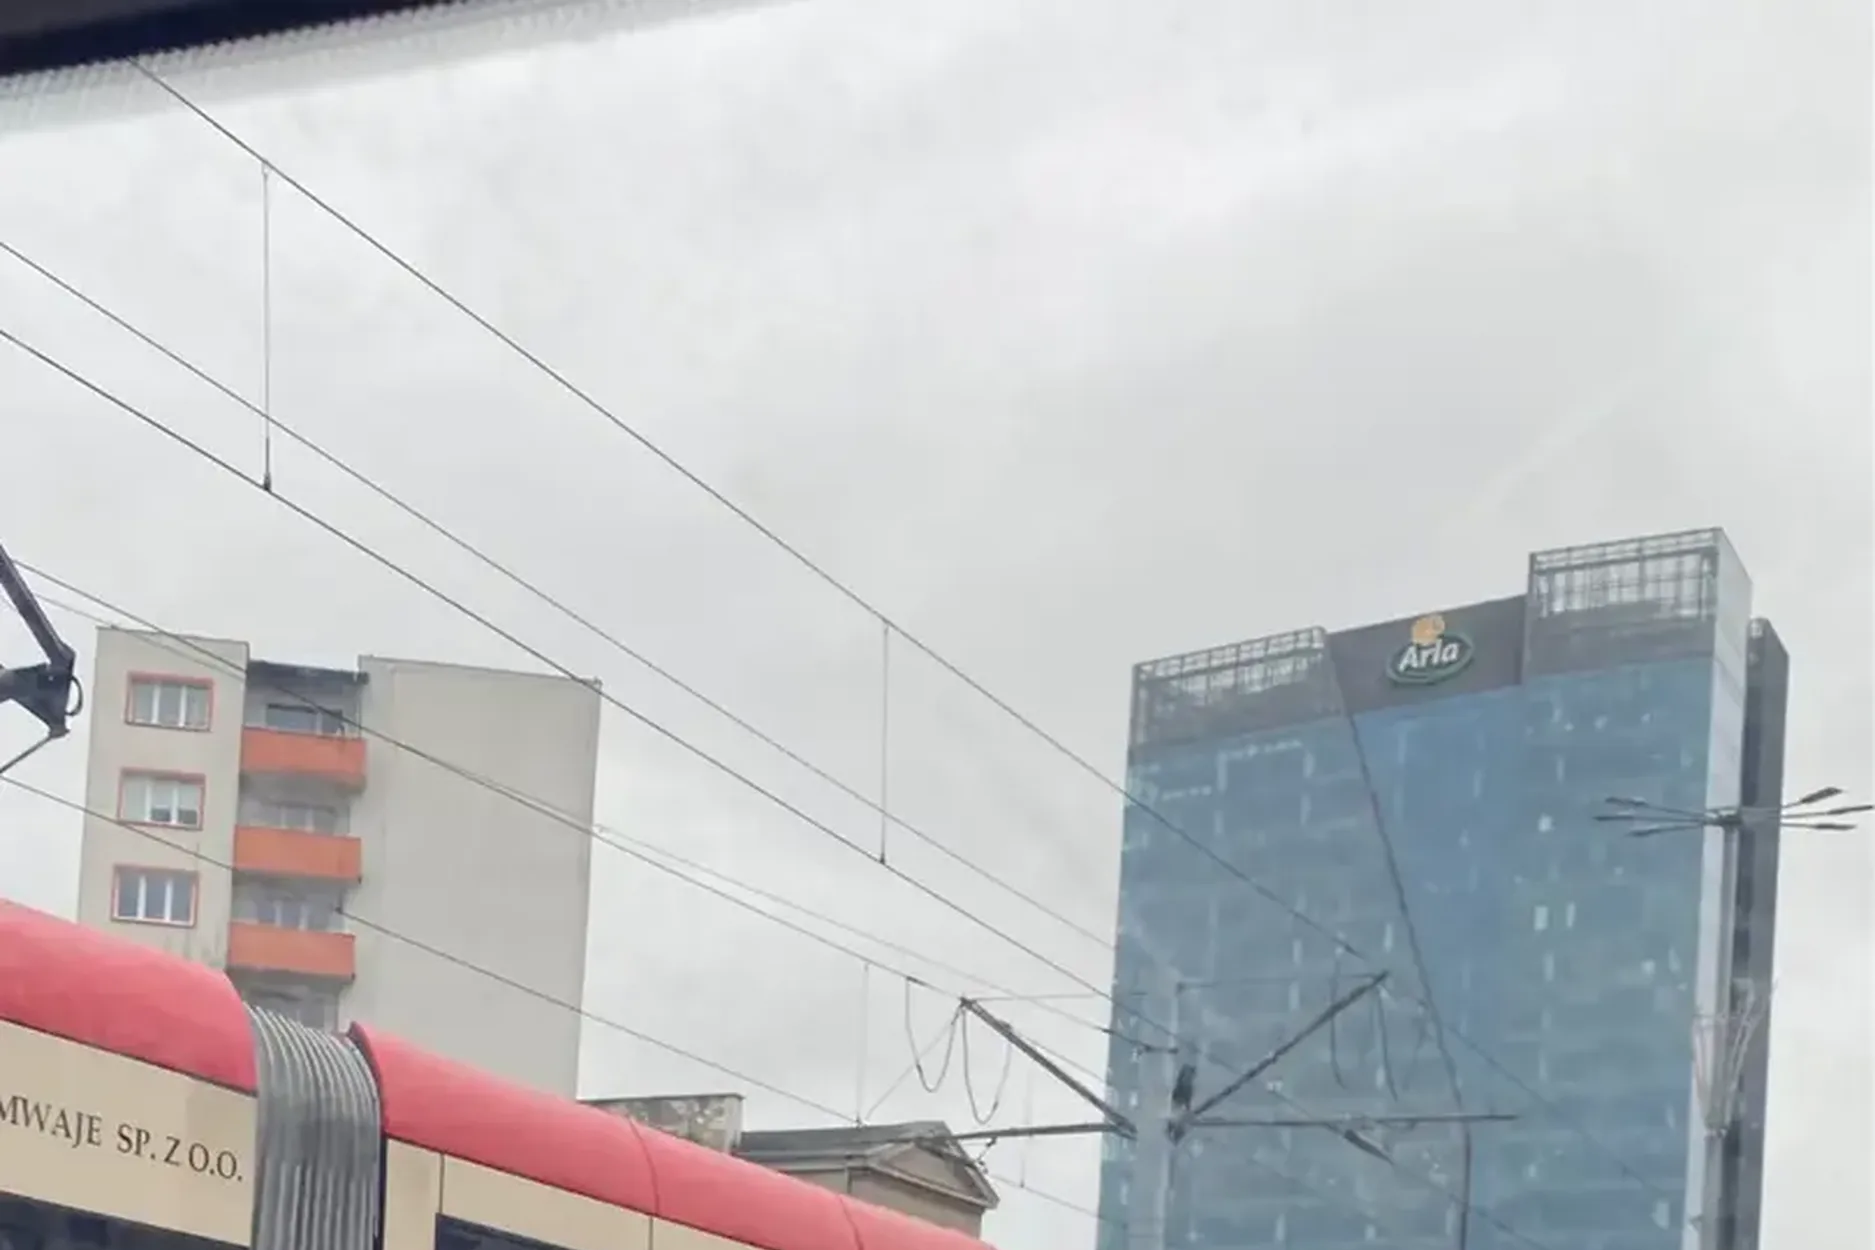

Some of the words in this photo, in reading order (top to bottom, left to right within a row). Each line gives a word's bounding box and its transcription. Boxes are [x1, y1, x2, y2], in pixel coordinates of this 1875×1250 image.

[1398, 638, 1460, 672] Arla
[0, 1095, 102, 1148] MWAJE
[117, 1123, 156, 1160] SP.
[163, 1136, 181, 1166] Z
[188, 1142, 243, 1182] O.O.
